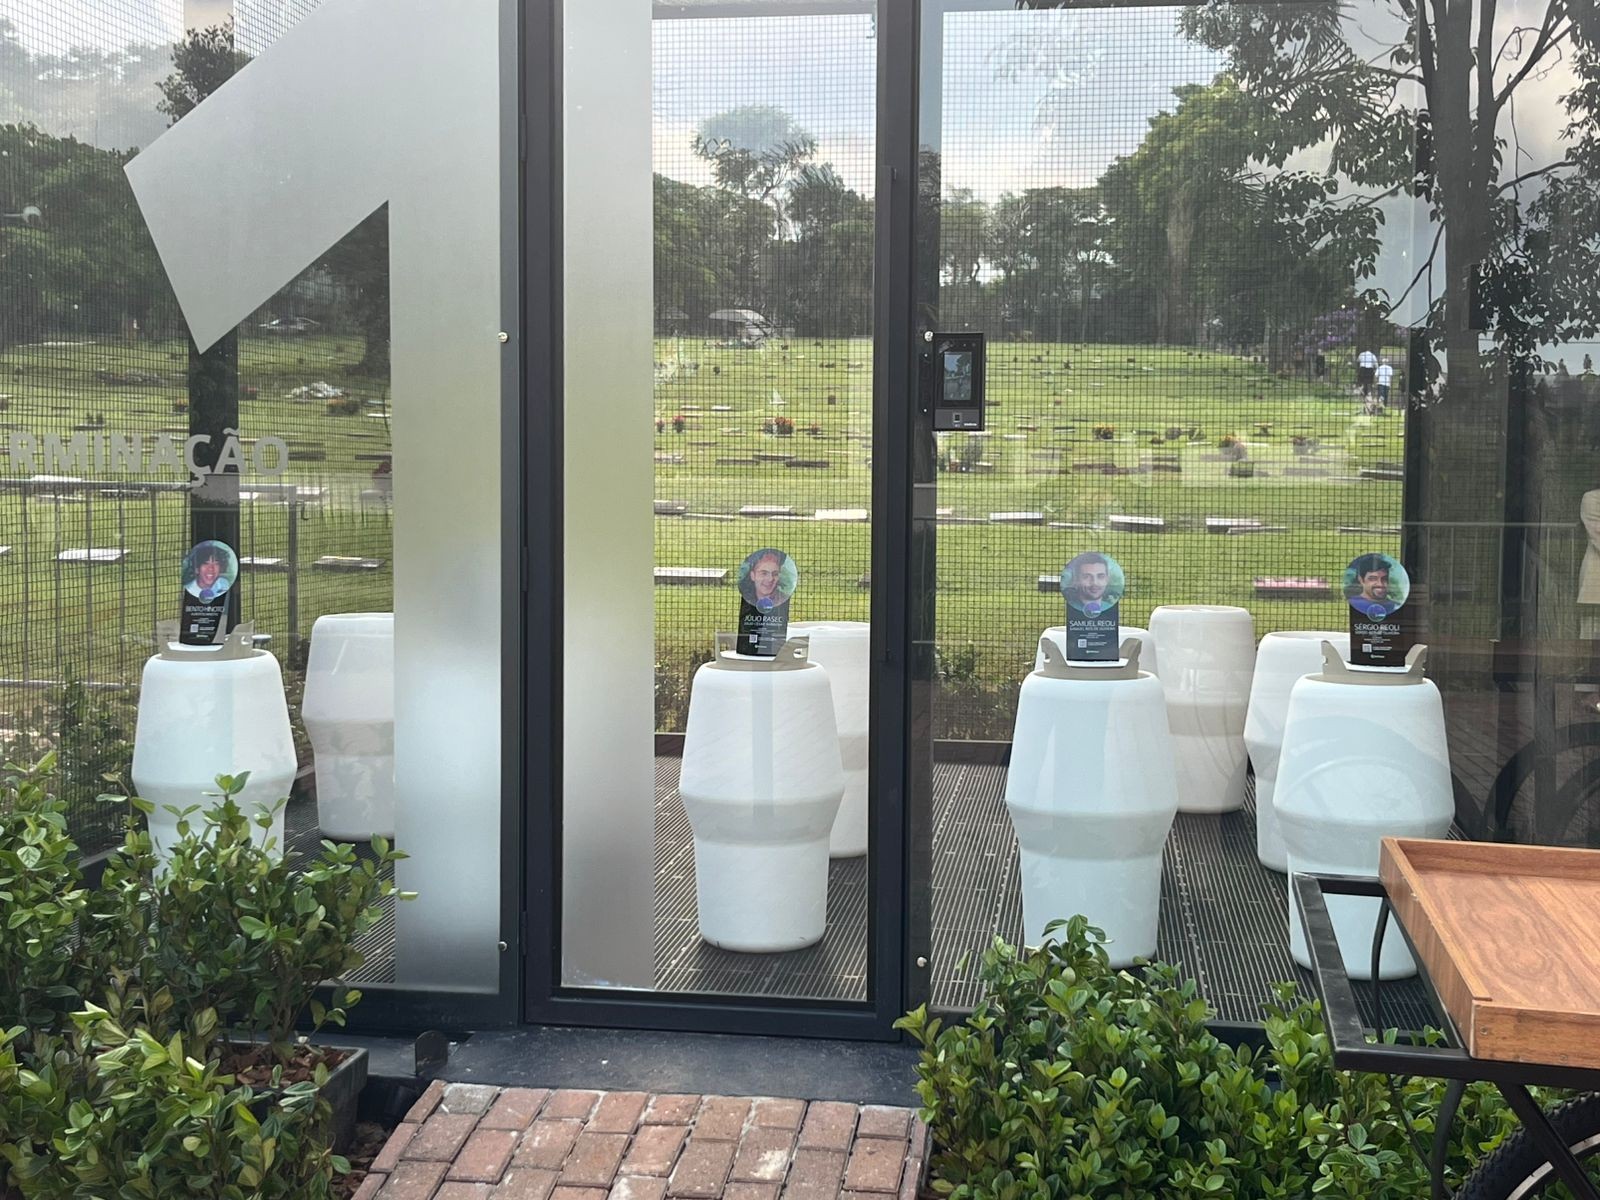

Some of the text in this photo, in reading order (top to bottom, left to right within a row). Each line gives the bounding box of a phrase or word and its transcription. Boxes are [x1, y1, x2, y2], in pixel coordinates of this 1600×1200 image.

[9, 427, 289, 488] RMINAÇÃO
[763, 615, 783, 623] RASEC
[1354, 623, 1379, 631] SÉRGIO
